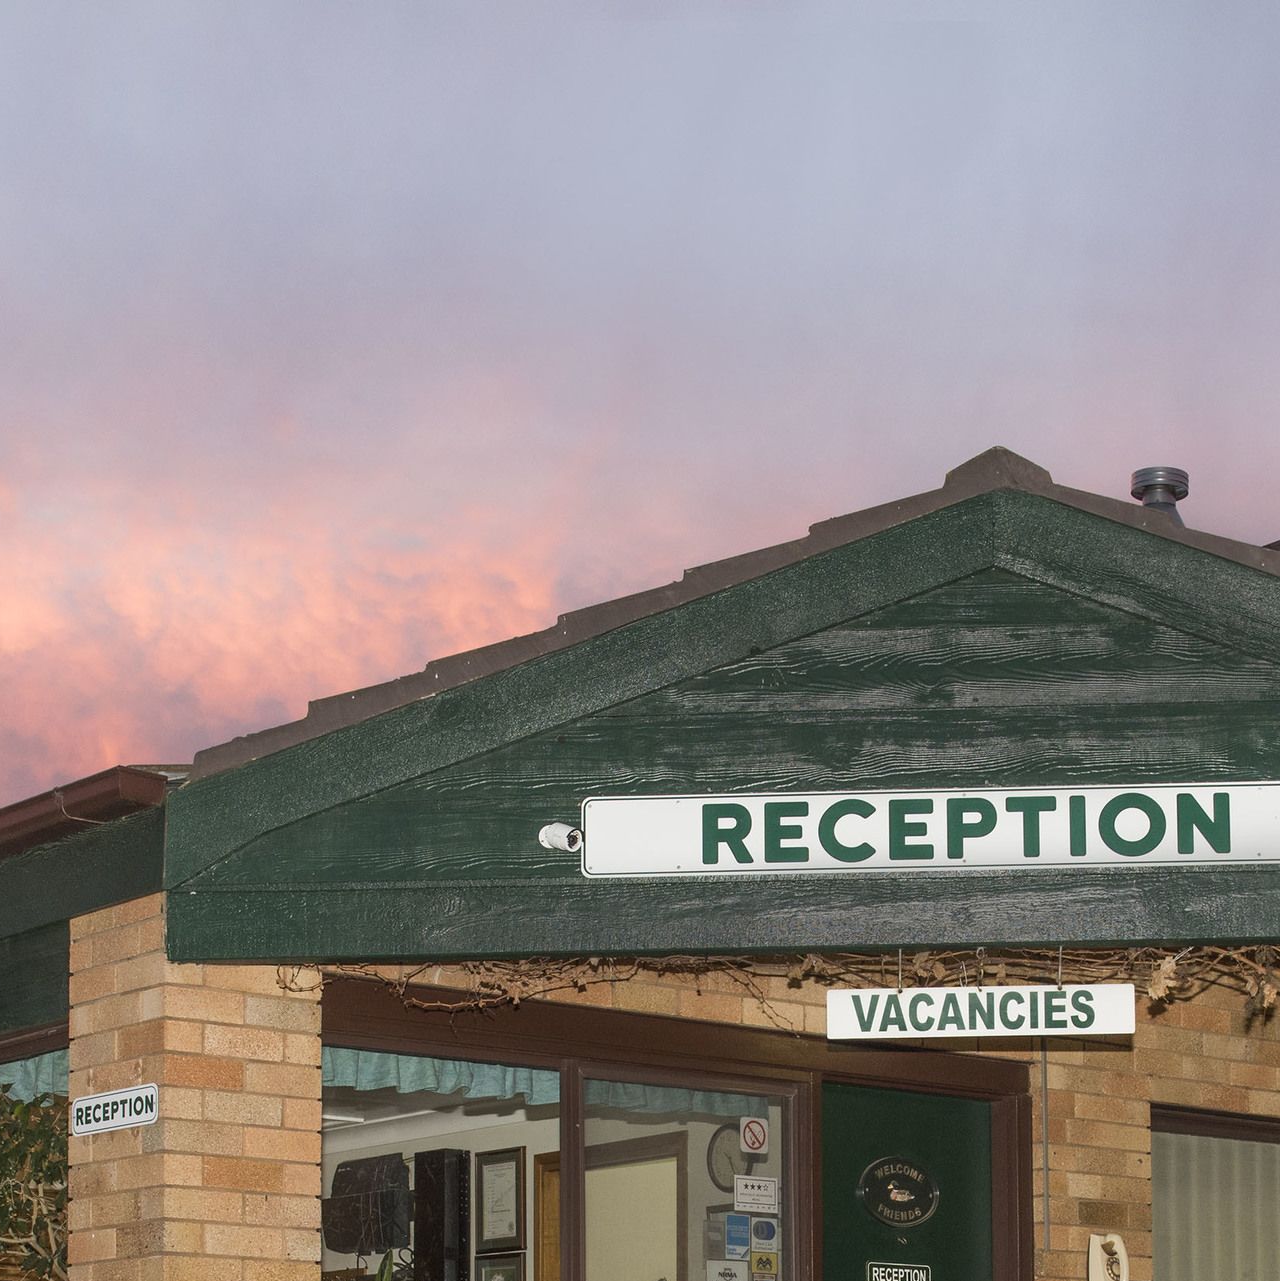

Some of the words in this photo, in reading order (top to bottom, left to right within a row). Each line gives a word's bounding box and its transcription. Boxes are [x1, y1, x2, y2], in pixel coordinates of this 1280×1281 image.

[702, 792, 1232, 865] RECEPTION
[851, 989, 1096, 1032] VACANCIES
[75, 1094, 154, 1127] RECEPTION
[875, 1163, 925, 1184] WELCOME
[877, 1203, 922, 1222] FRIENDS
